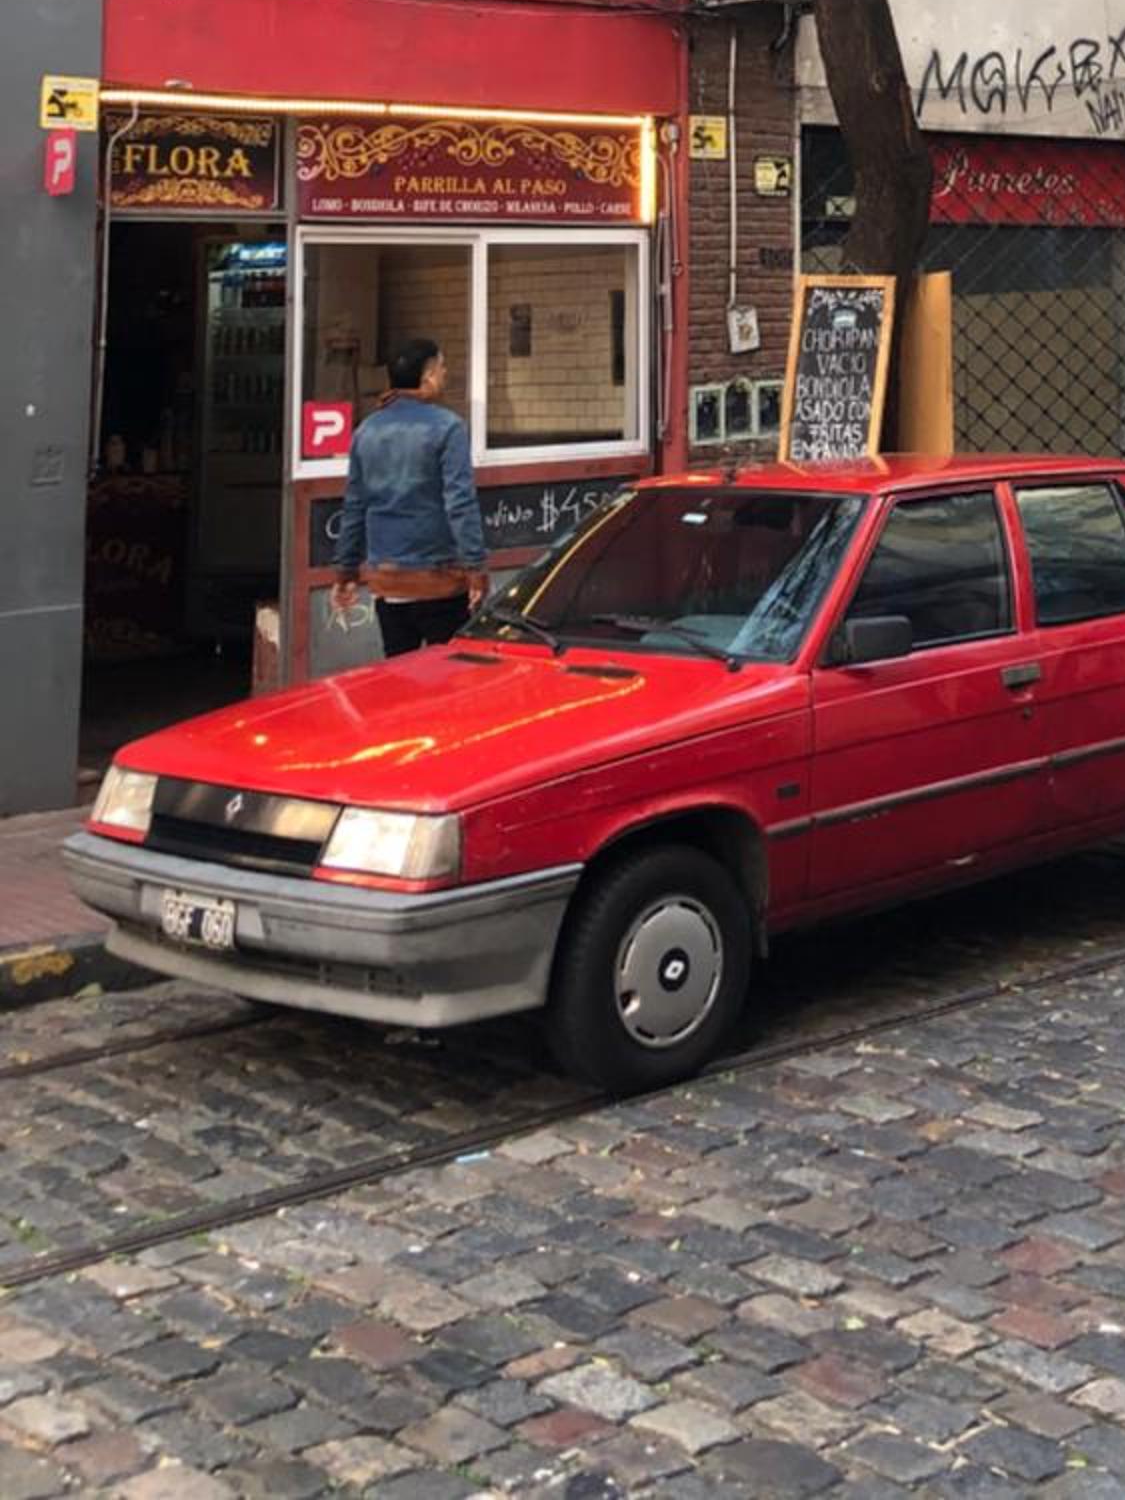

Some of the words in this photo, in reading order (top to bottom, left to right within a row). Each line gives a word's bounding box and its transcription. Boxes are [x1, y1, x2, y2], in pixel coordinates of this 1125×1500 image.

[122, 143, 252, 178] FLORA
[394, 176, 487, 194] PARRILLA
[493, 178, 516, 194] AL
[520, 179, 568, 196] PASO
[796, 373, 871, 401] BONDIOLA
